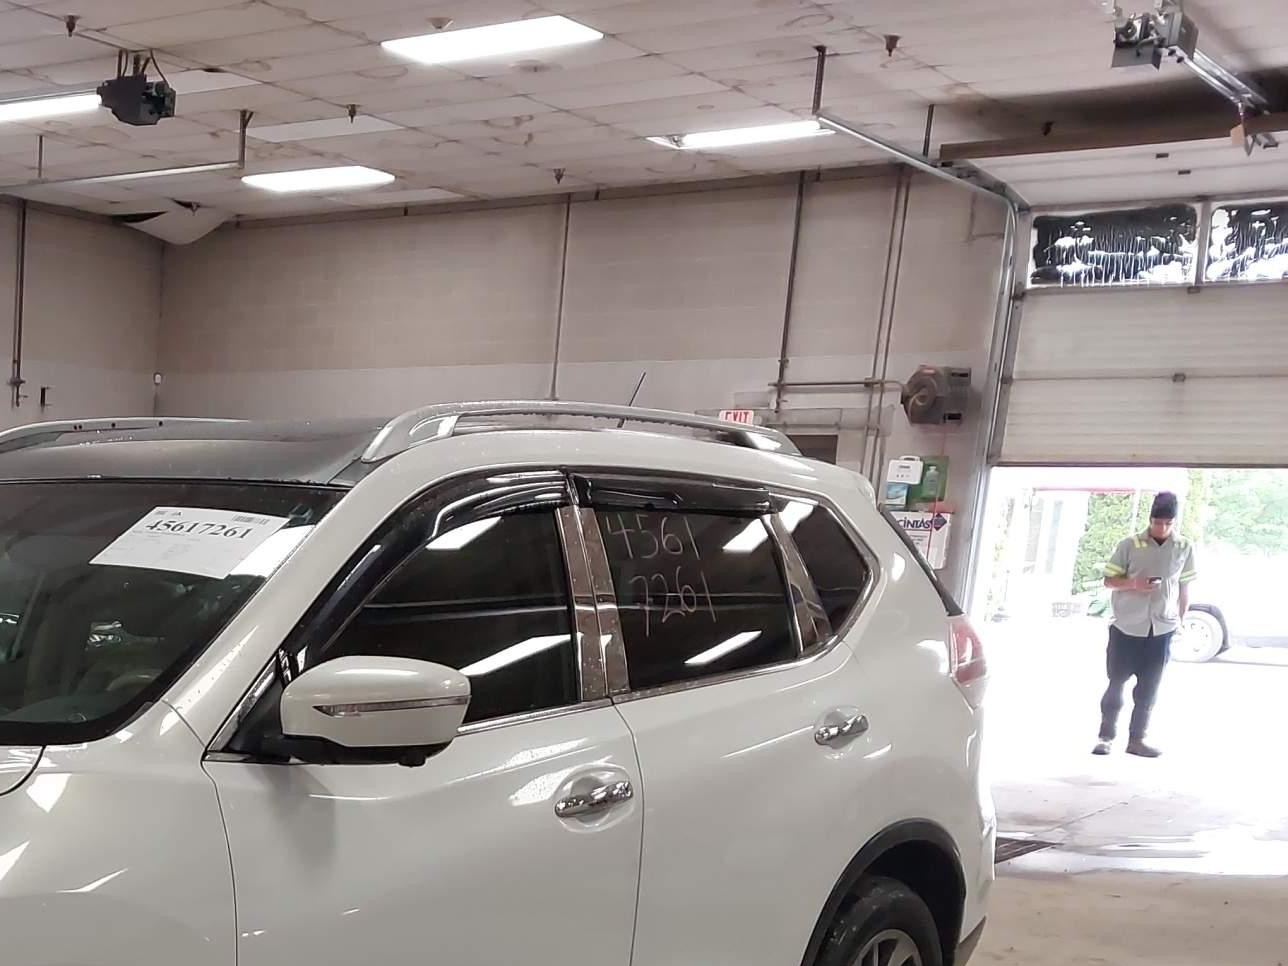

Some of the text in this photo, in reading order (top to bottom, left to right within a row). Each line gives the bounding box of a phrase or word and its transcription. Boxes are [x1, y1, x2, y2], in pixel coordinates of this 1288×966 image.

[145, 519, 253, 539] 45617261
[605, 512, 701, 561] 4561
[627, 565, 717, 638] 7261
